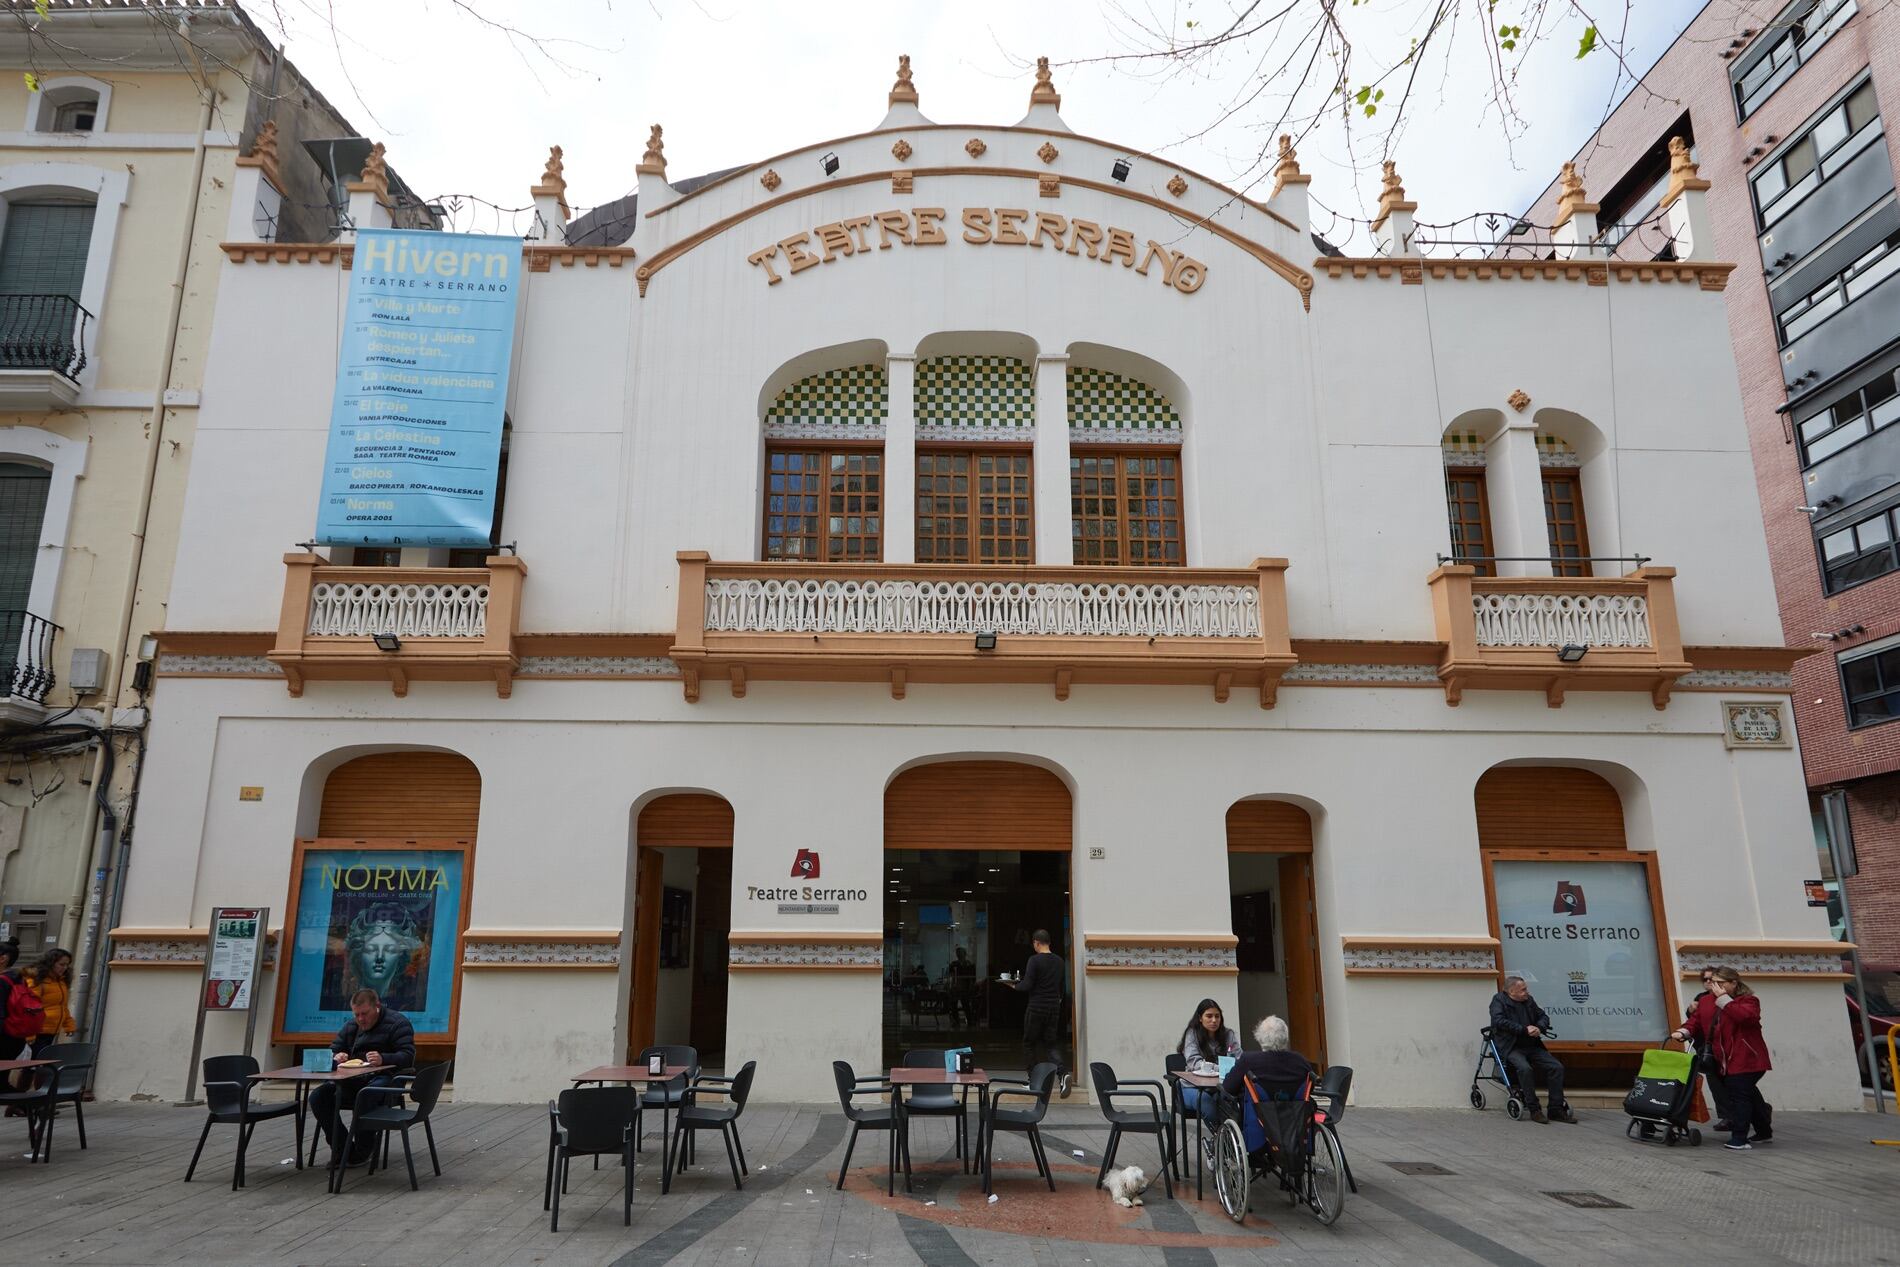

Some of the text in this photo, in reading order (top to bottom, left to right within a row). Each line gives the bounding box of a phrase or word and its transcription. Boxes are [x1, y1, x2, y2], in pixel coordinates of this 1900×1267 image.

[747, 207, 1208, 294] TEATRE SERRANO
[364, 238, 509, 279] Hivern
[361, 276, 508, 293] TEATRE SERRANO
[418, 303, 462, 315] Marte
[371, 312, 390, 320] RON
[369, 326, 416, 342] Romeo
[420, 332, 428, 345] y
[431, 330, 476, 345] Julieta
[365, 355, 417, 366] ENTRECAJAS
[362, 371, 378, 382] La
[381, 371, 419, 385] vidua
[423, 374, 495, 390] valenciana
[372, 385, 423, 395] VALENCIANA
[359, 400, 372, 412] El
[382, 415, 447, 426] PRODUCCIONES
[374, 428, 441, 445] Celestina
[354, 445, 397, 453] SECUENCIA
[407, 453, 439, 462] ROMEA
[409, 483, 484, 496] ROKAMBOLESKAS
[347, 498, 395, 511] Norma
[1092, 848, 1102, 857] 29
[319, 863, 449, 891] NORMA
[747, 886, 867, 901] Teatre Serrano
[1504, 923, 1641, 941] Teatre Serrano
[1587, 1007, 1601, 1016] DE
[1603, 1006, 1644, 1017] GANDIA
